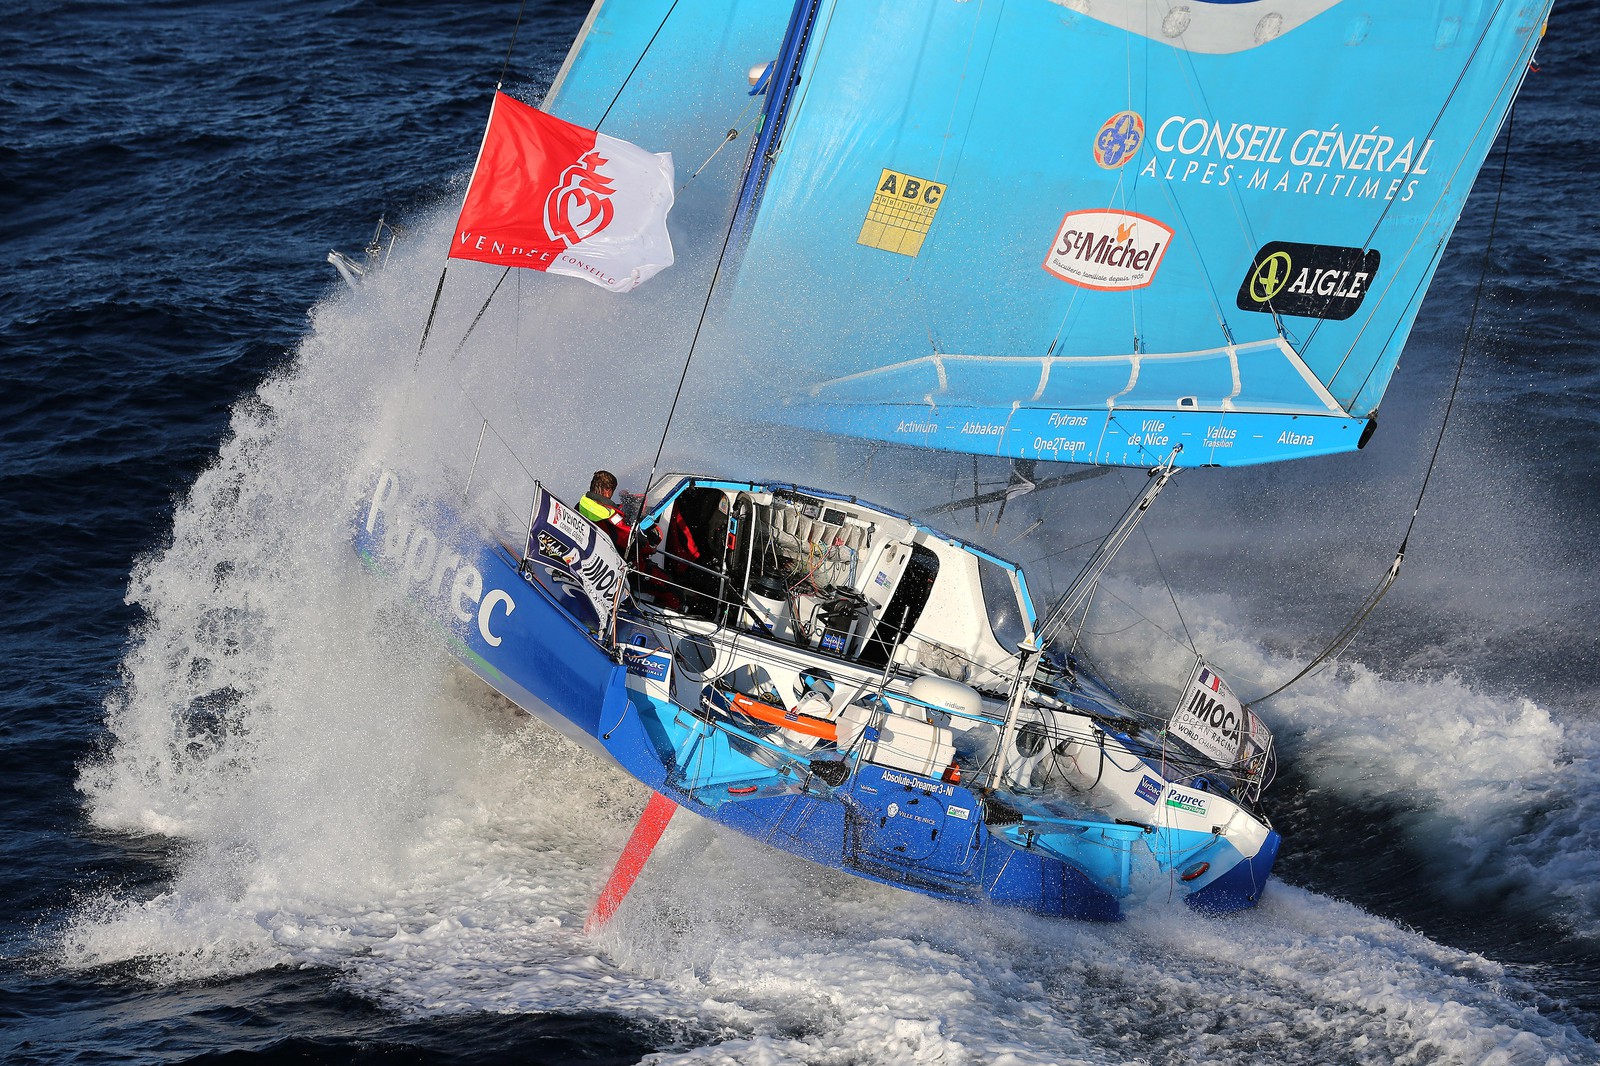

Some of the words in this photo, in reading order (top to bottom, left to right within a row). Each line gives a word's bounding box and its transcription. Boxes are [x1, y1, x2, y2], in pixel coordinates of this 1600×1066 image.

[1155, 115, 1288, 163] CONSEIL
[1289, 123, 1436, 175] GÉNÉRAL
[880, 173, 942, 204] ABC
[562, 255, 606, 280] CONSEIL
[1108, 275, 1130, 284] depuis
[1287, 267, 1369, 299] AIGLE
[896, 419, 938, 433] Activium
[961, 421, 1005, 435] Abbakan
[1047, 412, 1089, 428] Flytrans
[1141, 419, 1165, 432] Ville
[1127, 432, 1142, 446] de
[1143, 433, 1170, 446] Nice
[1206, 425, 1238, 439] Valtus
[1276, 430, 1315, 446] Altana
[1033, 437, 1086, 451] One2Team
[1202, 438, 1234, 449] Transition
[945, 701, 965, 711] iridium
[1187, 688, 1241, 746] IMOCA
[1178, 724, 1199, 741] WORLD
[1182, 713, 1211, 736] OCEAN
[1210, 731, 1237, 756] RACING
[881, 770, 939, 794] Absolute-Dreamer
[1141, 777, 1161, 796] Virbac
[1167, 788, 1206, 808] Paprec
[899, 811, 913, 821] VILLE
